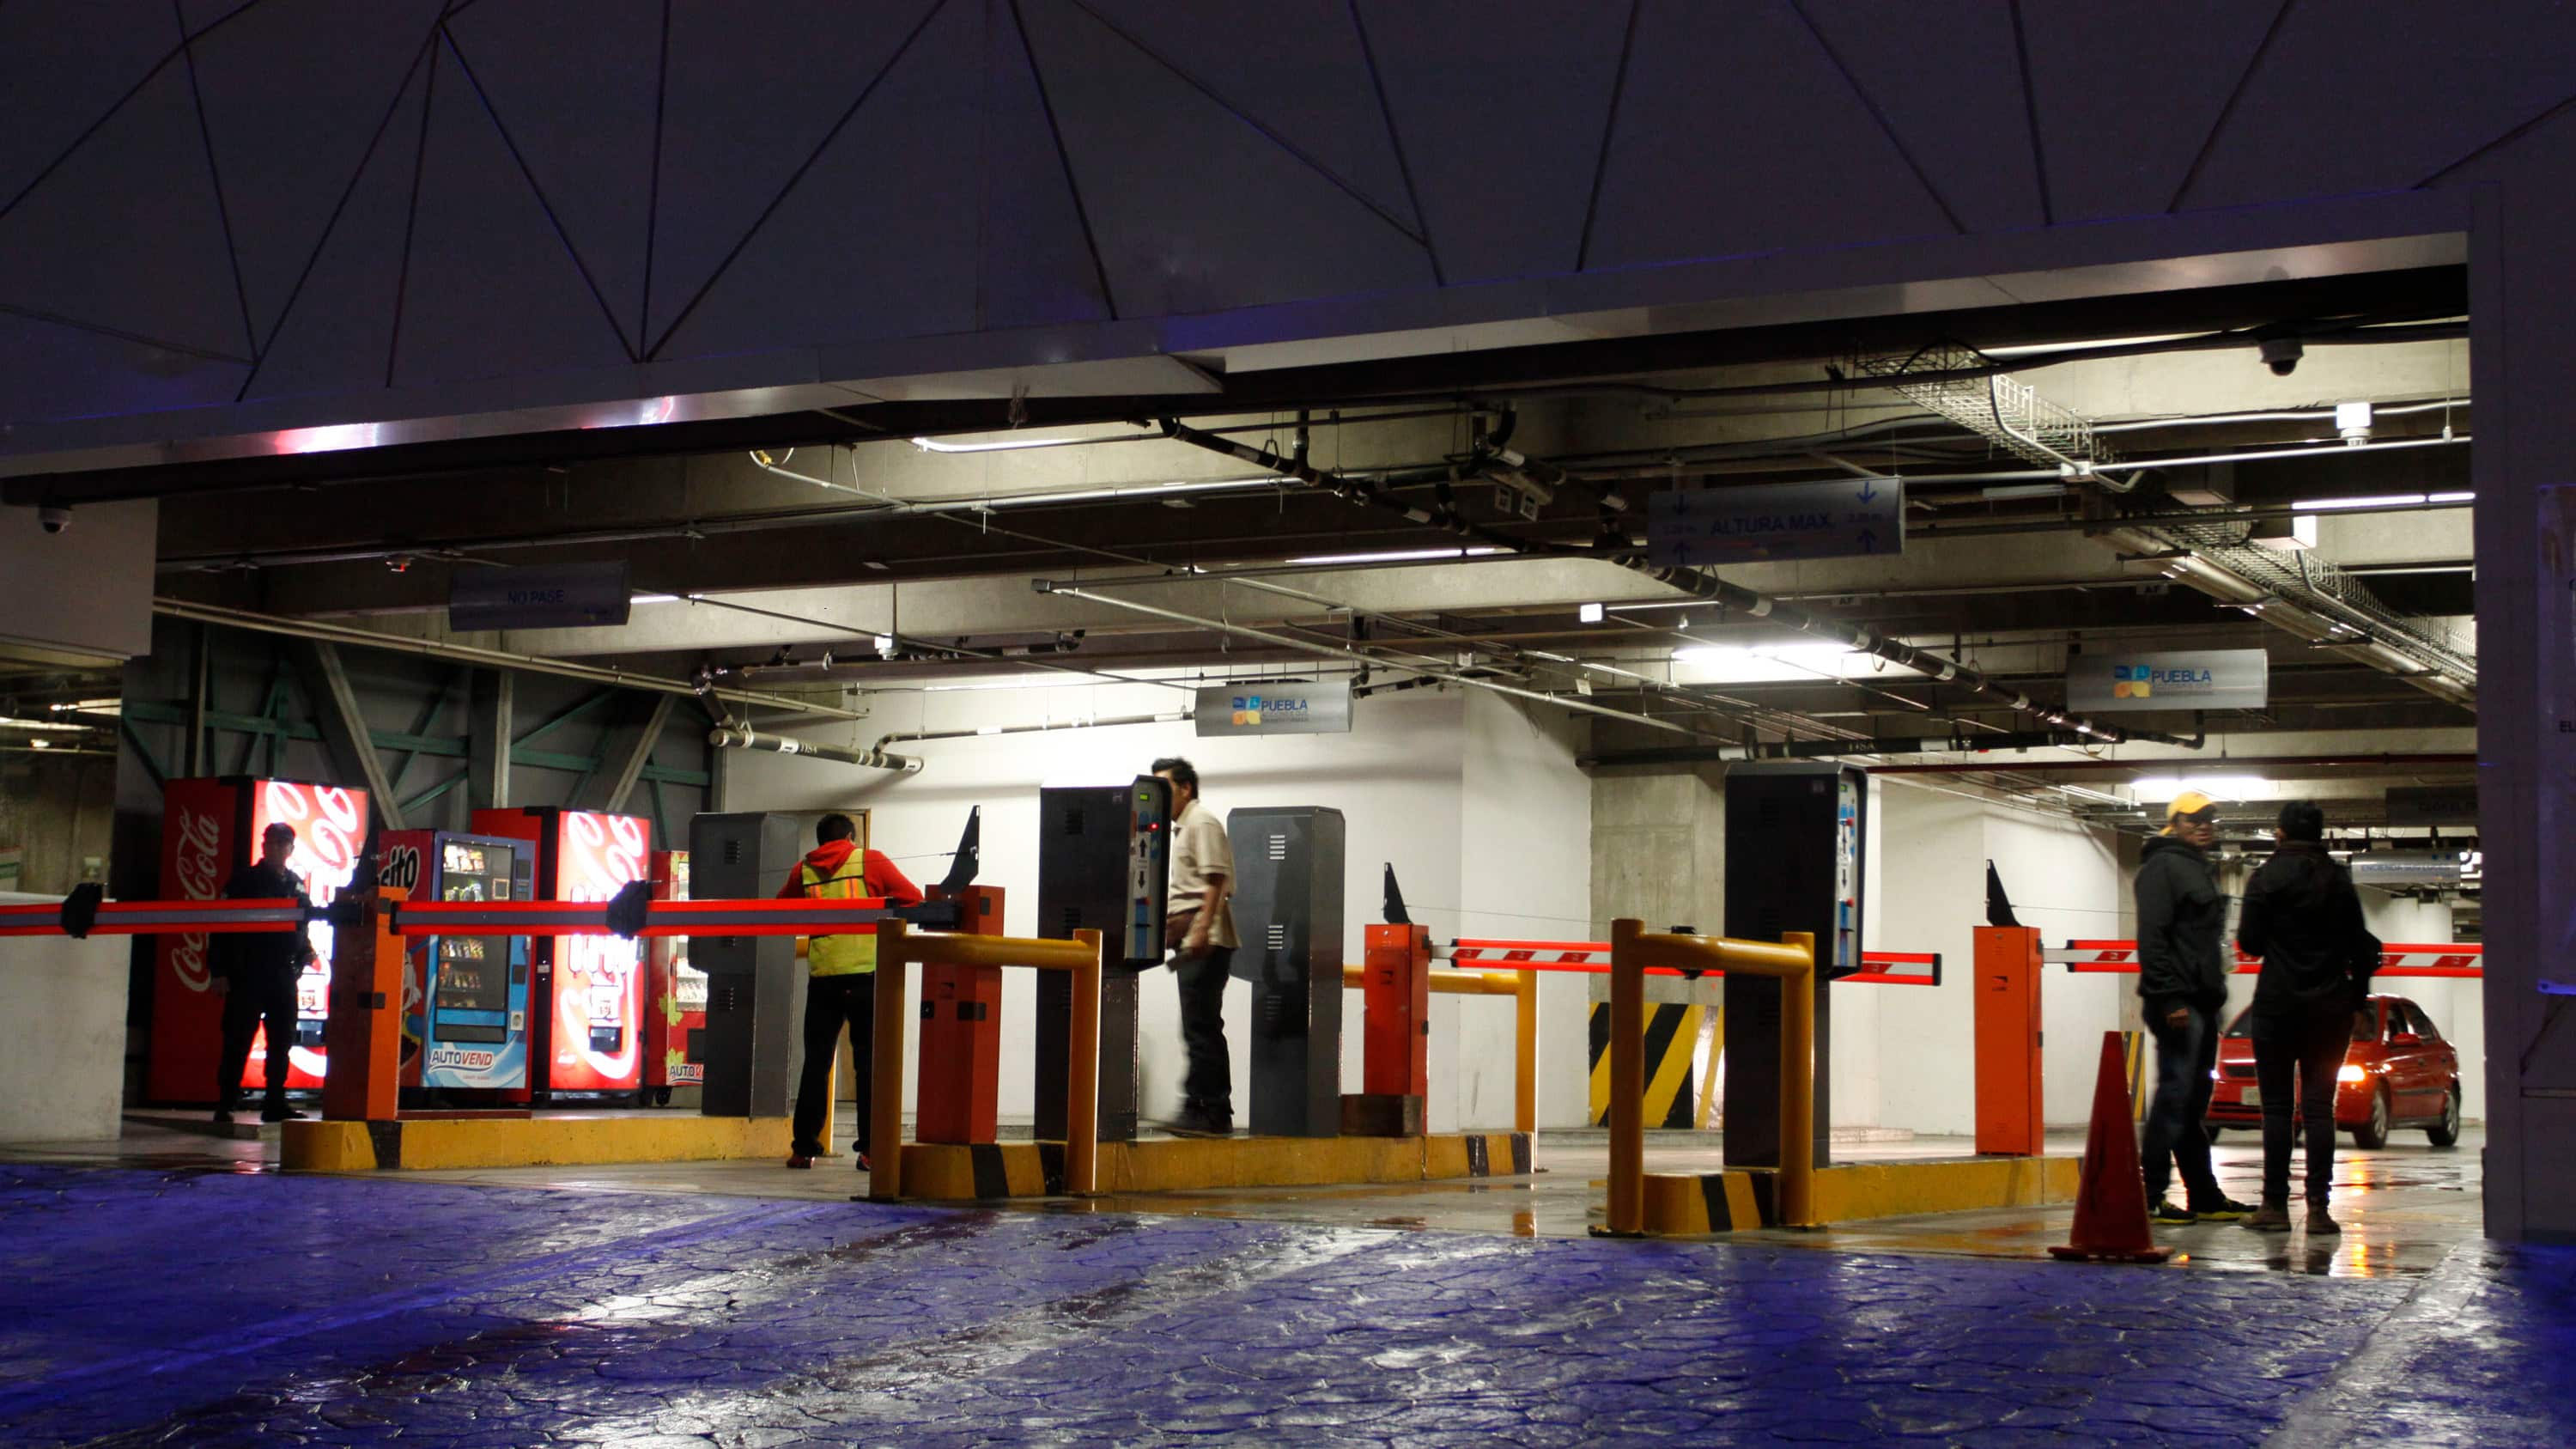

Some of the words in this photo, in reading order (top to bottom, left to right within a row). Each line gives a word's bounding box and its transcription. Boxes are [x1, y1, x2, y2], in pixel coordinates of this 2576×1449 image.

[1710, 515, 1785, 535] ALTURA
[507, 590, 527, 605] NO
[530, 589, 564, 604] PASE
[2151, 670, 2213, 683] PUEBLA
[1261, 699, 1309, 711] PUEBLA
[431, 1050, 493, 1066] AUTOVEND
[670, 1065, 702, 1077] AUTOV
